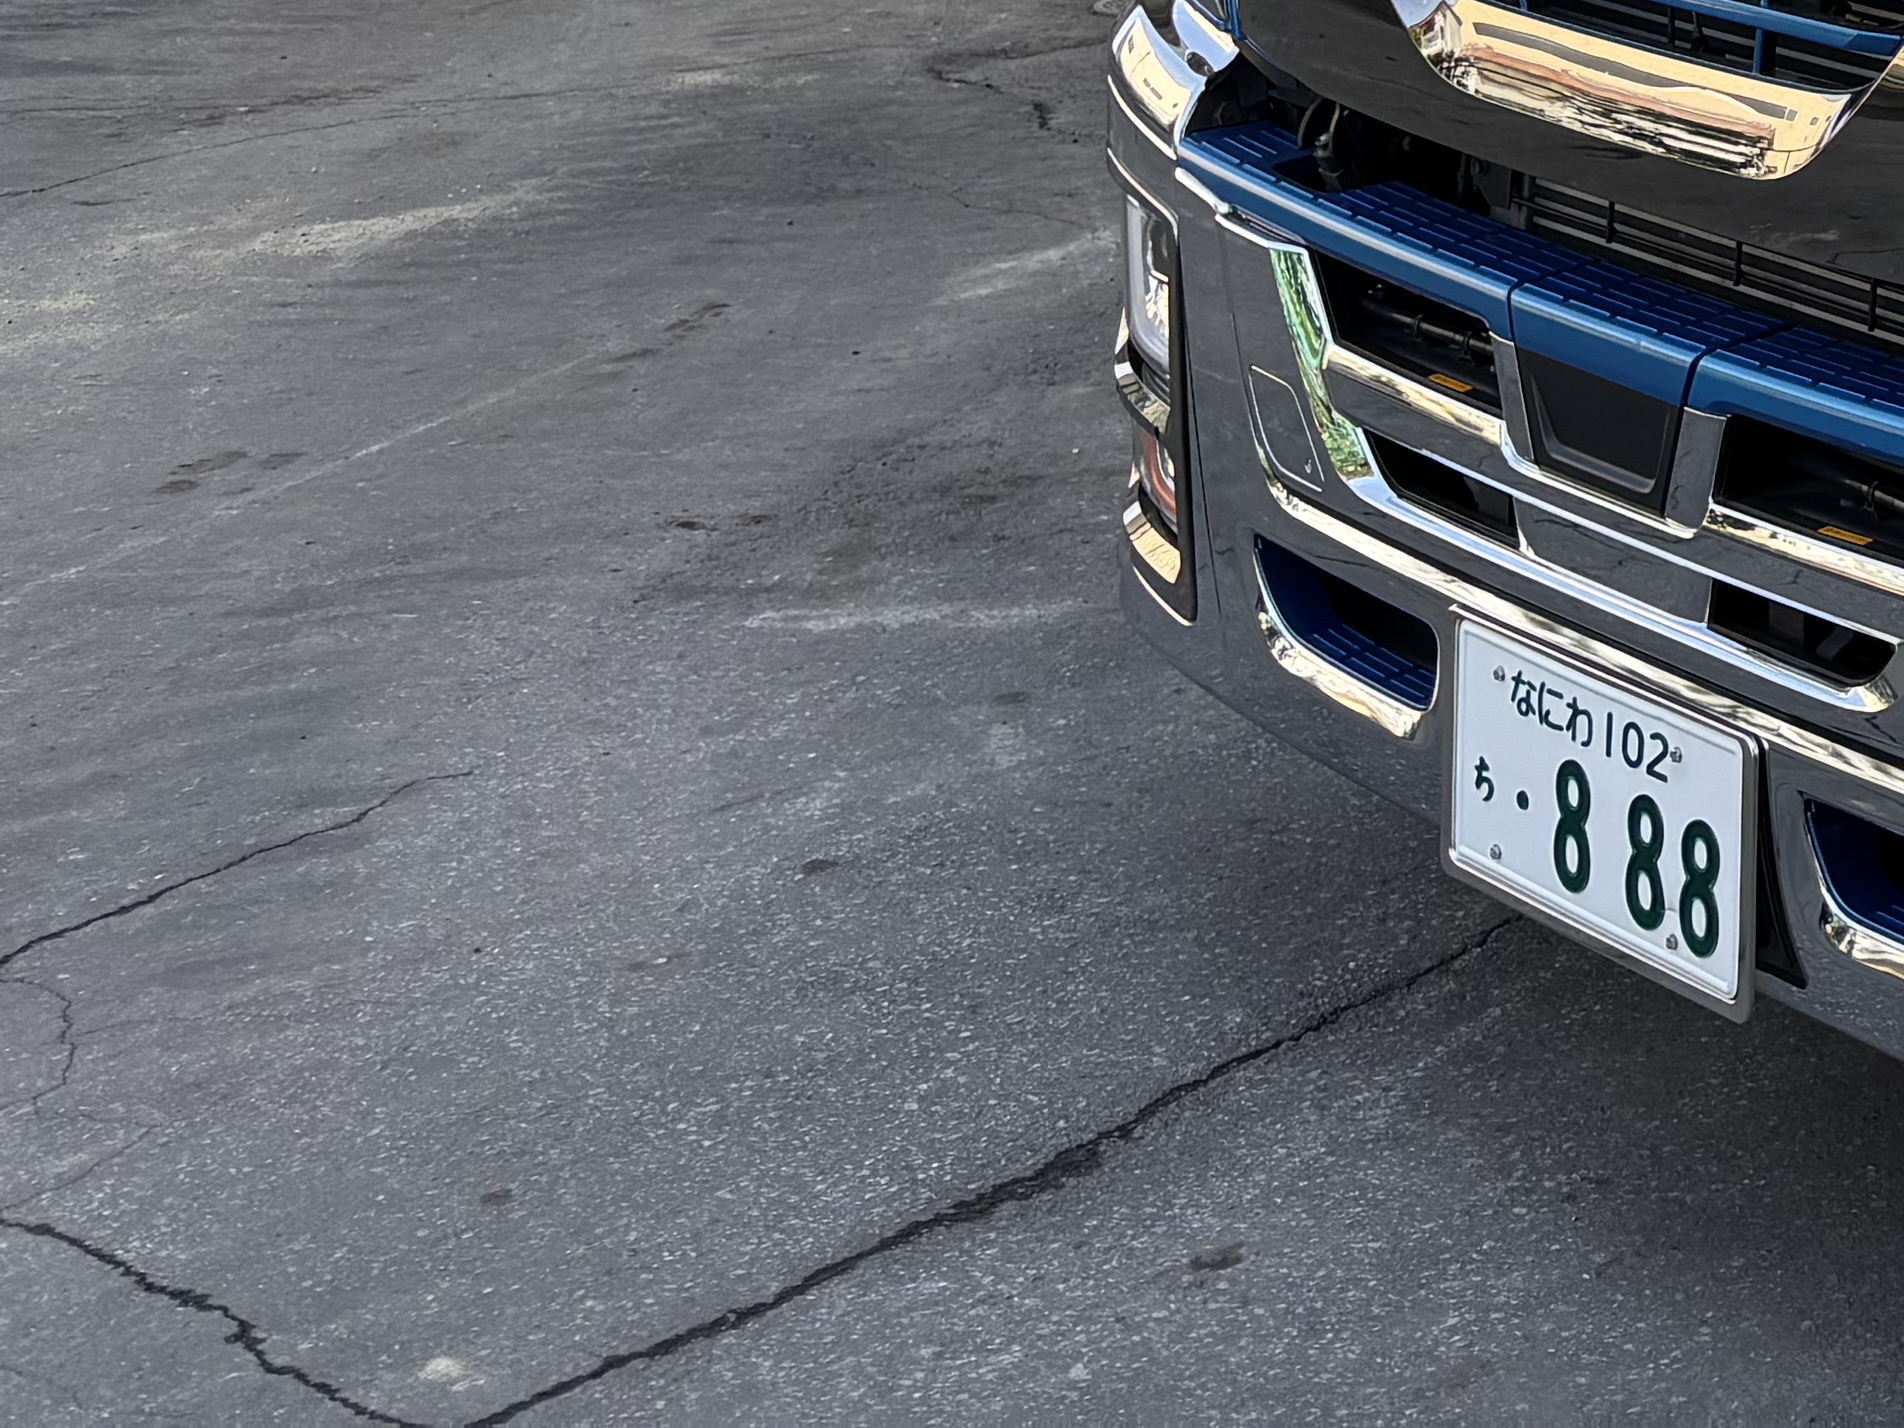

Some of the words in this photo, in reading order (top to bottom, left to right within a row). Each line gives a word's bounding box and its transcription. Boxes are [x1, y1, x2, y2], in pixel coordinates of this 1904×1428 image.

[1510, 670, 1594, 748] なにわ
[1604, 711, 1671, 784] 102
[1473, 755, 1495, 802] ち
